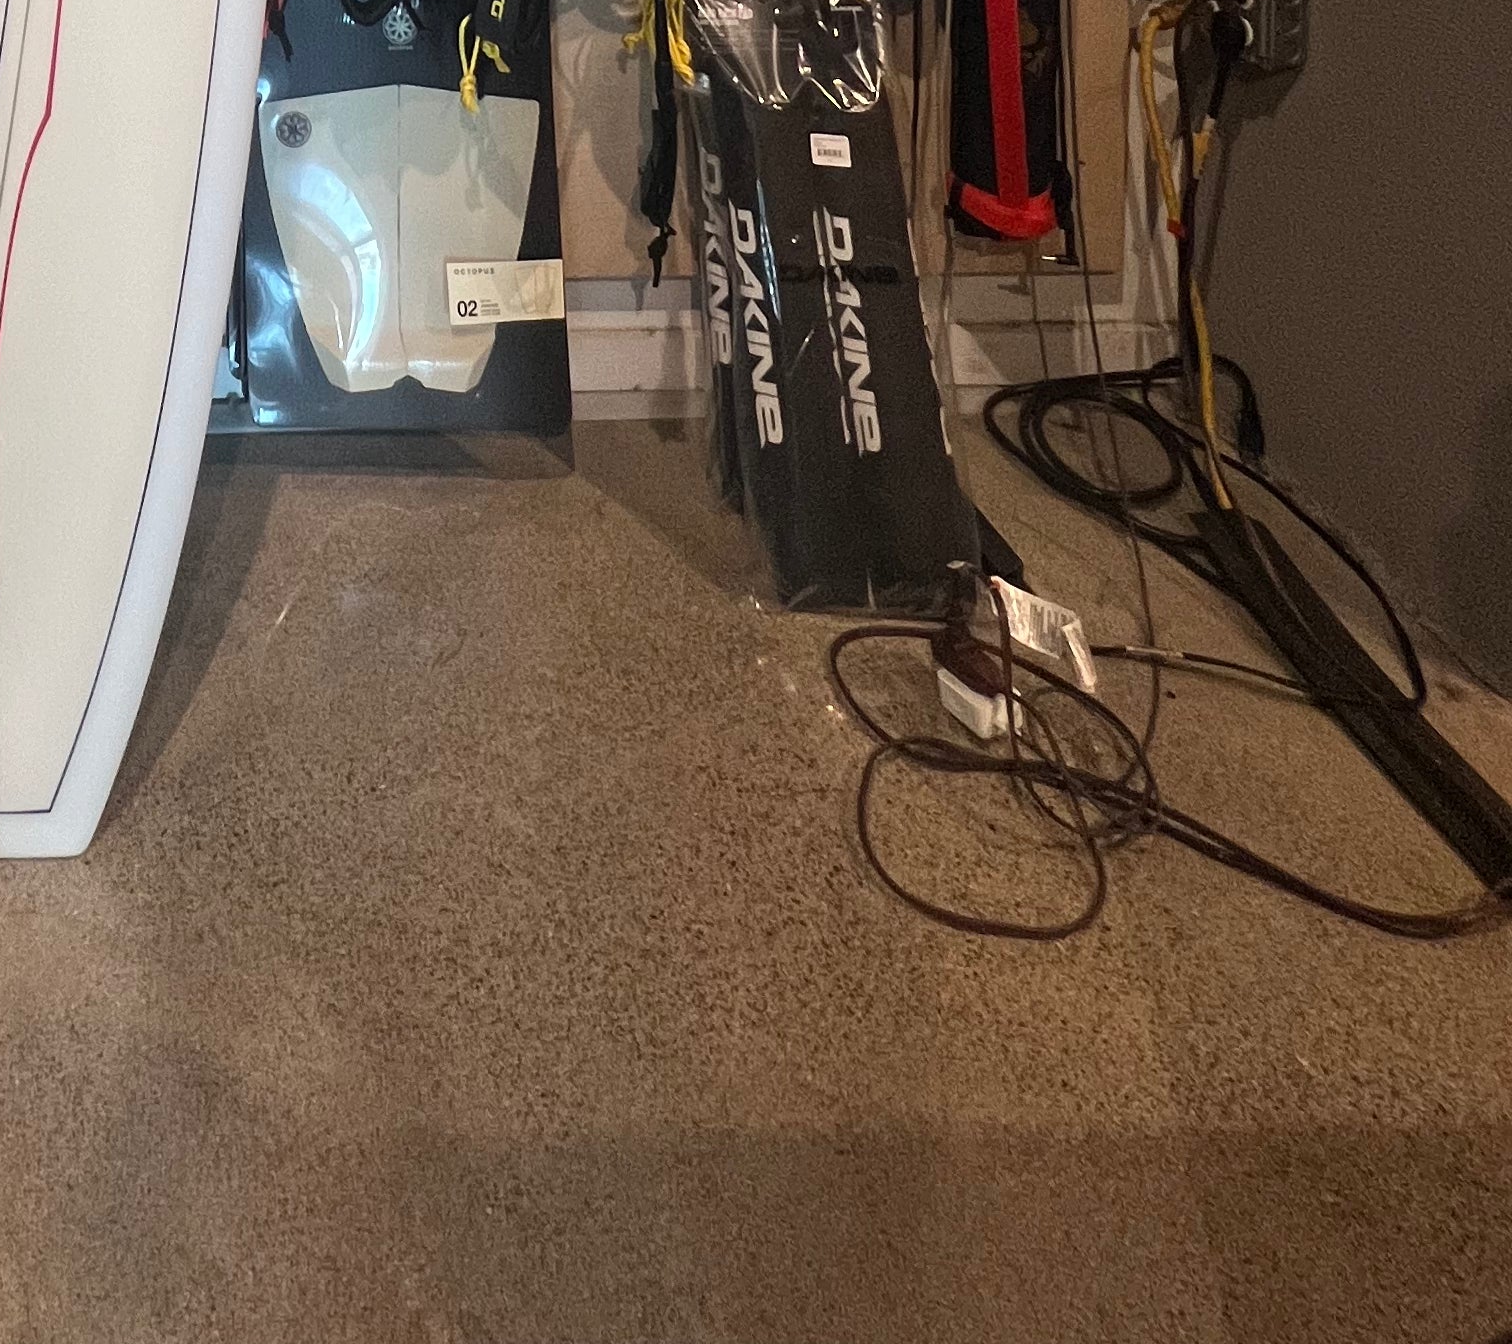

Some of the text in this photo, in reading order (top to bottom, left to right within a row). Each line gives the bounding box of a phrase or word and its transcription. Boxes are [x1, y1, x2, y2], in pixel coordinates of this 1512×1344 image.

[453, 267, 495, 276] OCTOPUS
[457, 299, 478, 318] 02
[699, 146, 733, 365] DAKINE
[728, 198, 784, 449] DAKINE
[823, 206, 882, 459] DAKINE
